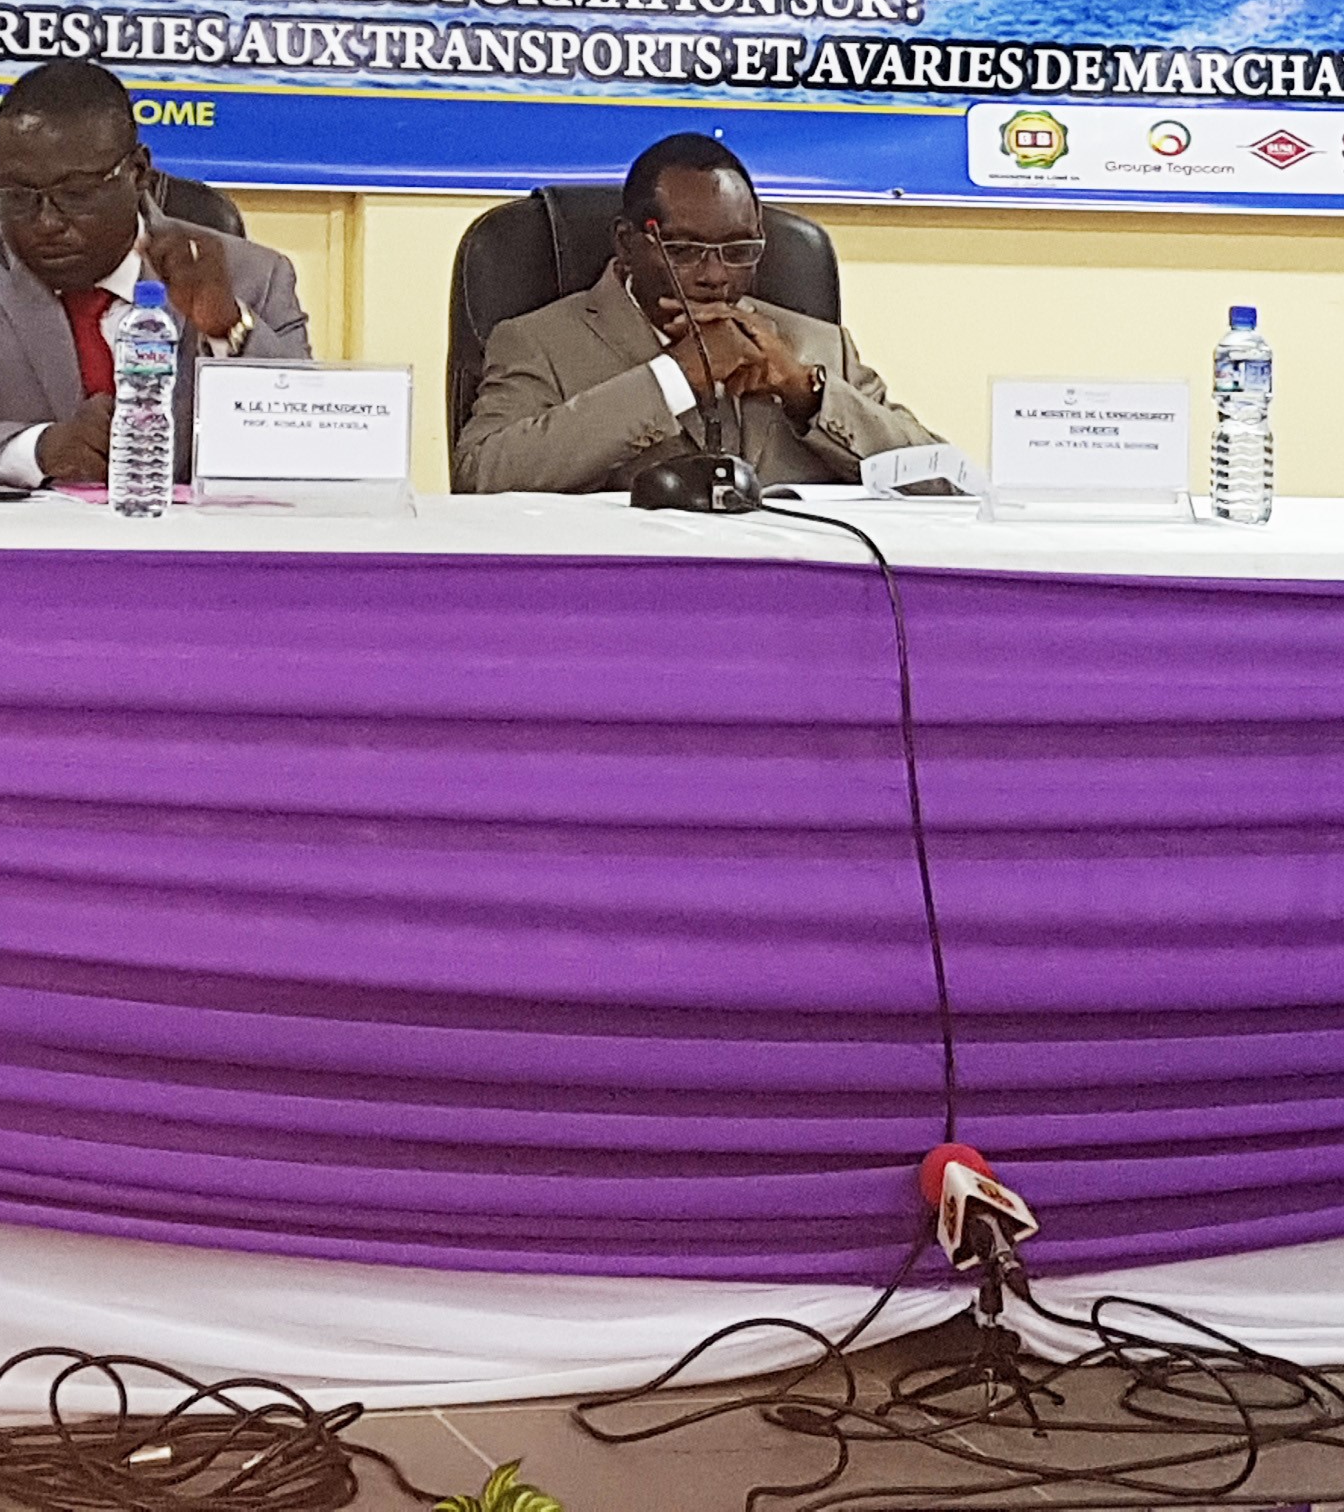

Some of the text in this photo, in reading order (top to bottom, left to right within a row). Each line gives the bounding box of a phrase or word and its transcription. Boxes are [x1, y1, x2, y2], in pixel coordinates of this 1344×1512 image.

[102, 17, 223, 63] LIES
[240, 21, 354, 68] AUX
[362, 25, 722, 78] TRANSPORTS
[732, 32, 803, 85] ET
[809, 42, 1024, 92] AVARIES
[1036, 50, 1109, 92] DE
[132, 99, 215, 126] OME
[1105, 161, 1235, 174] Groupe Togocom
